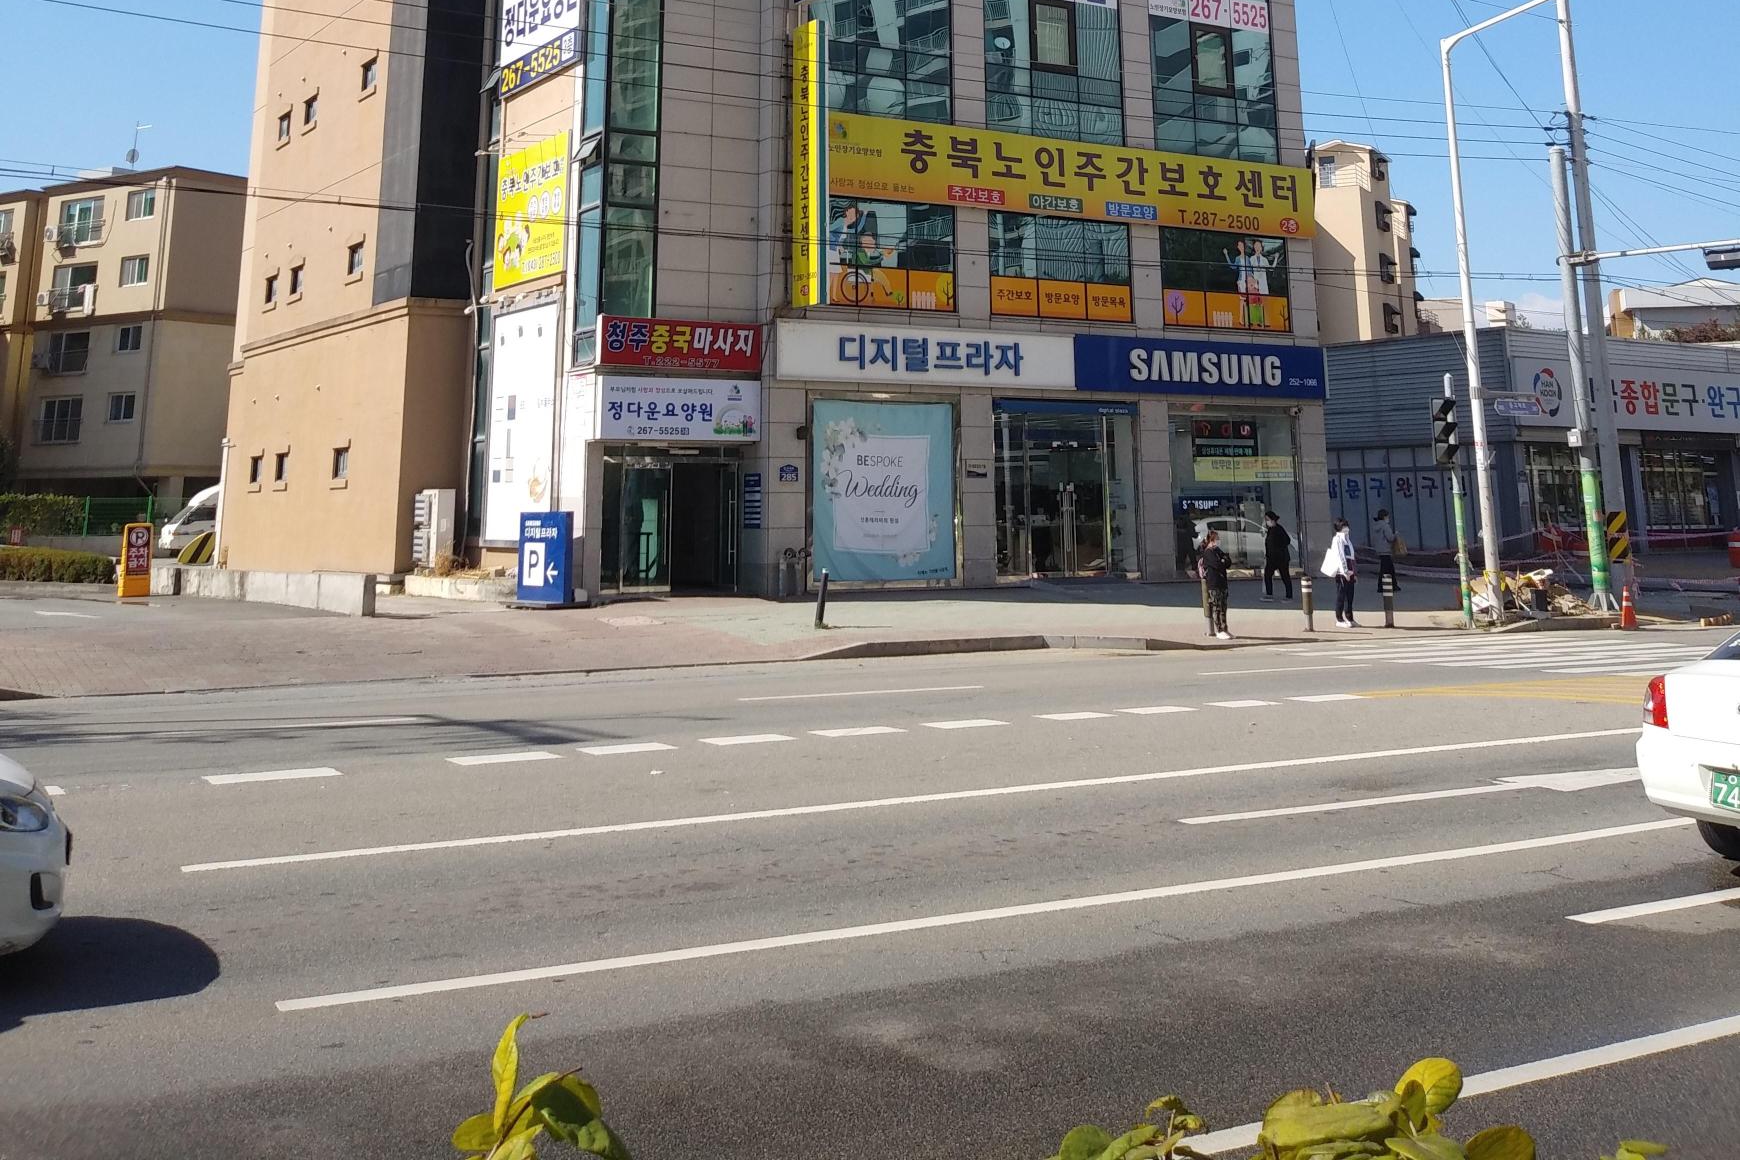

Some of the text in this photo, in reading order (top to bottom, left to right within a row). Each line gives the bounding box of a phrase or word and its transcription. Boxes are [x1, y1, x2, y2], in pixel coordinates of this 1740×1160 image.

[501, 40, 561, 94] 267-5525
[800, 64, 810, 258] 충북노인주간보호센터
[900, 129, 1299, 213] 충북노인주간보호센터
[951, 187, 1002, 205] 주간보호
[1032, 196, 1080, 213] 야간보호
[1108, 202, 1156, 221] 방문요양
[1178, 210, 1261, 232] T.287-2500
[997, 288, 1033, 301] 주간보호
[1045, 292, 1080, 306] 방문요양
[1092, 295, 1127, 309] 방문목욕
[838, 334, 1025, 377] 디지털프라자
[1129, 348, 1283, 388] SAMSUNG
[1541, 380, 1554, 388] HAN
[1540, 389, 1557, 397] KOOK
[607, 401, 713, 423] 정다운요양원
[856, 454, 904, 468] BESPOKE
[781, 473, 797, 481] 285
[836, 469, 924, 509] Wedding
[525, 527, 558, 539] 디지털프라자
[128, 547, 149, 557] 주차
[128, 558, 147, 568] 금지
